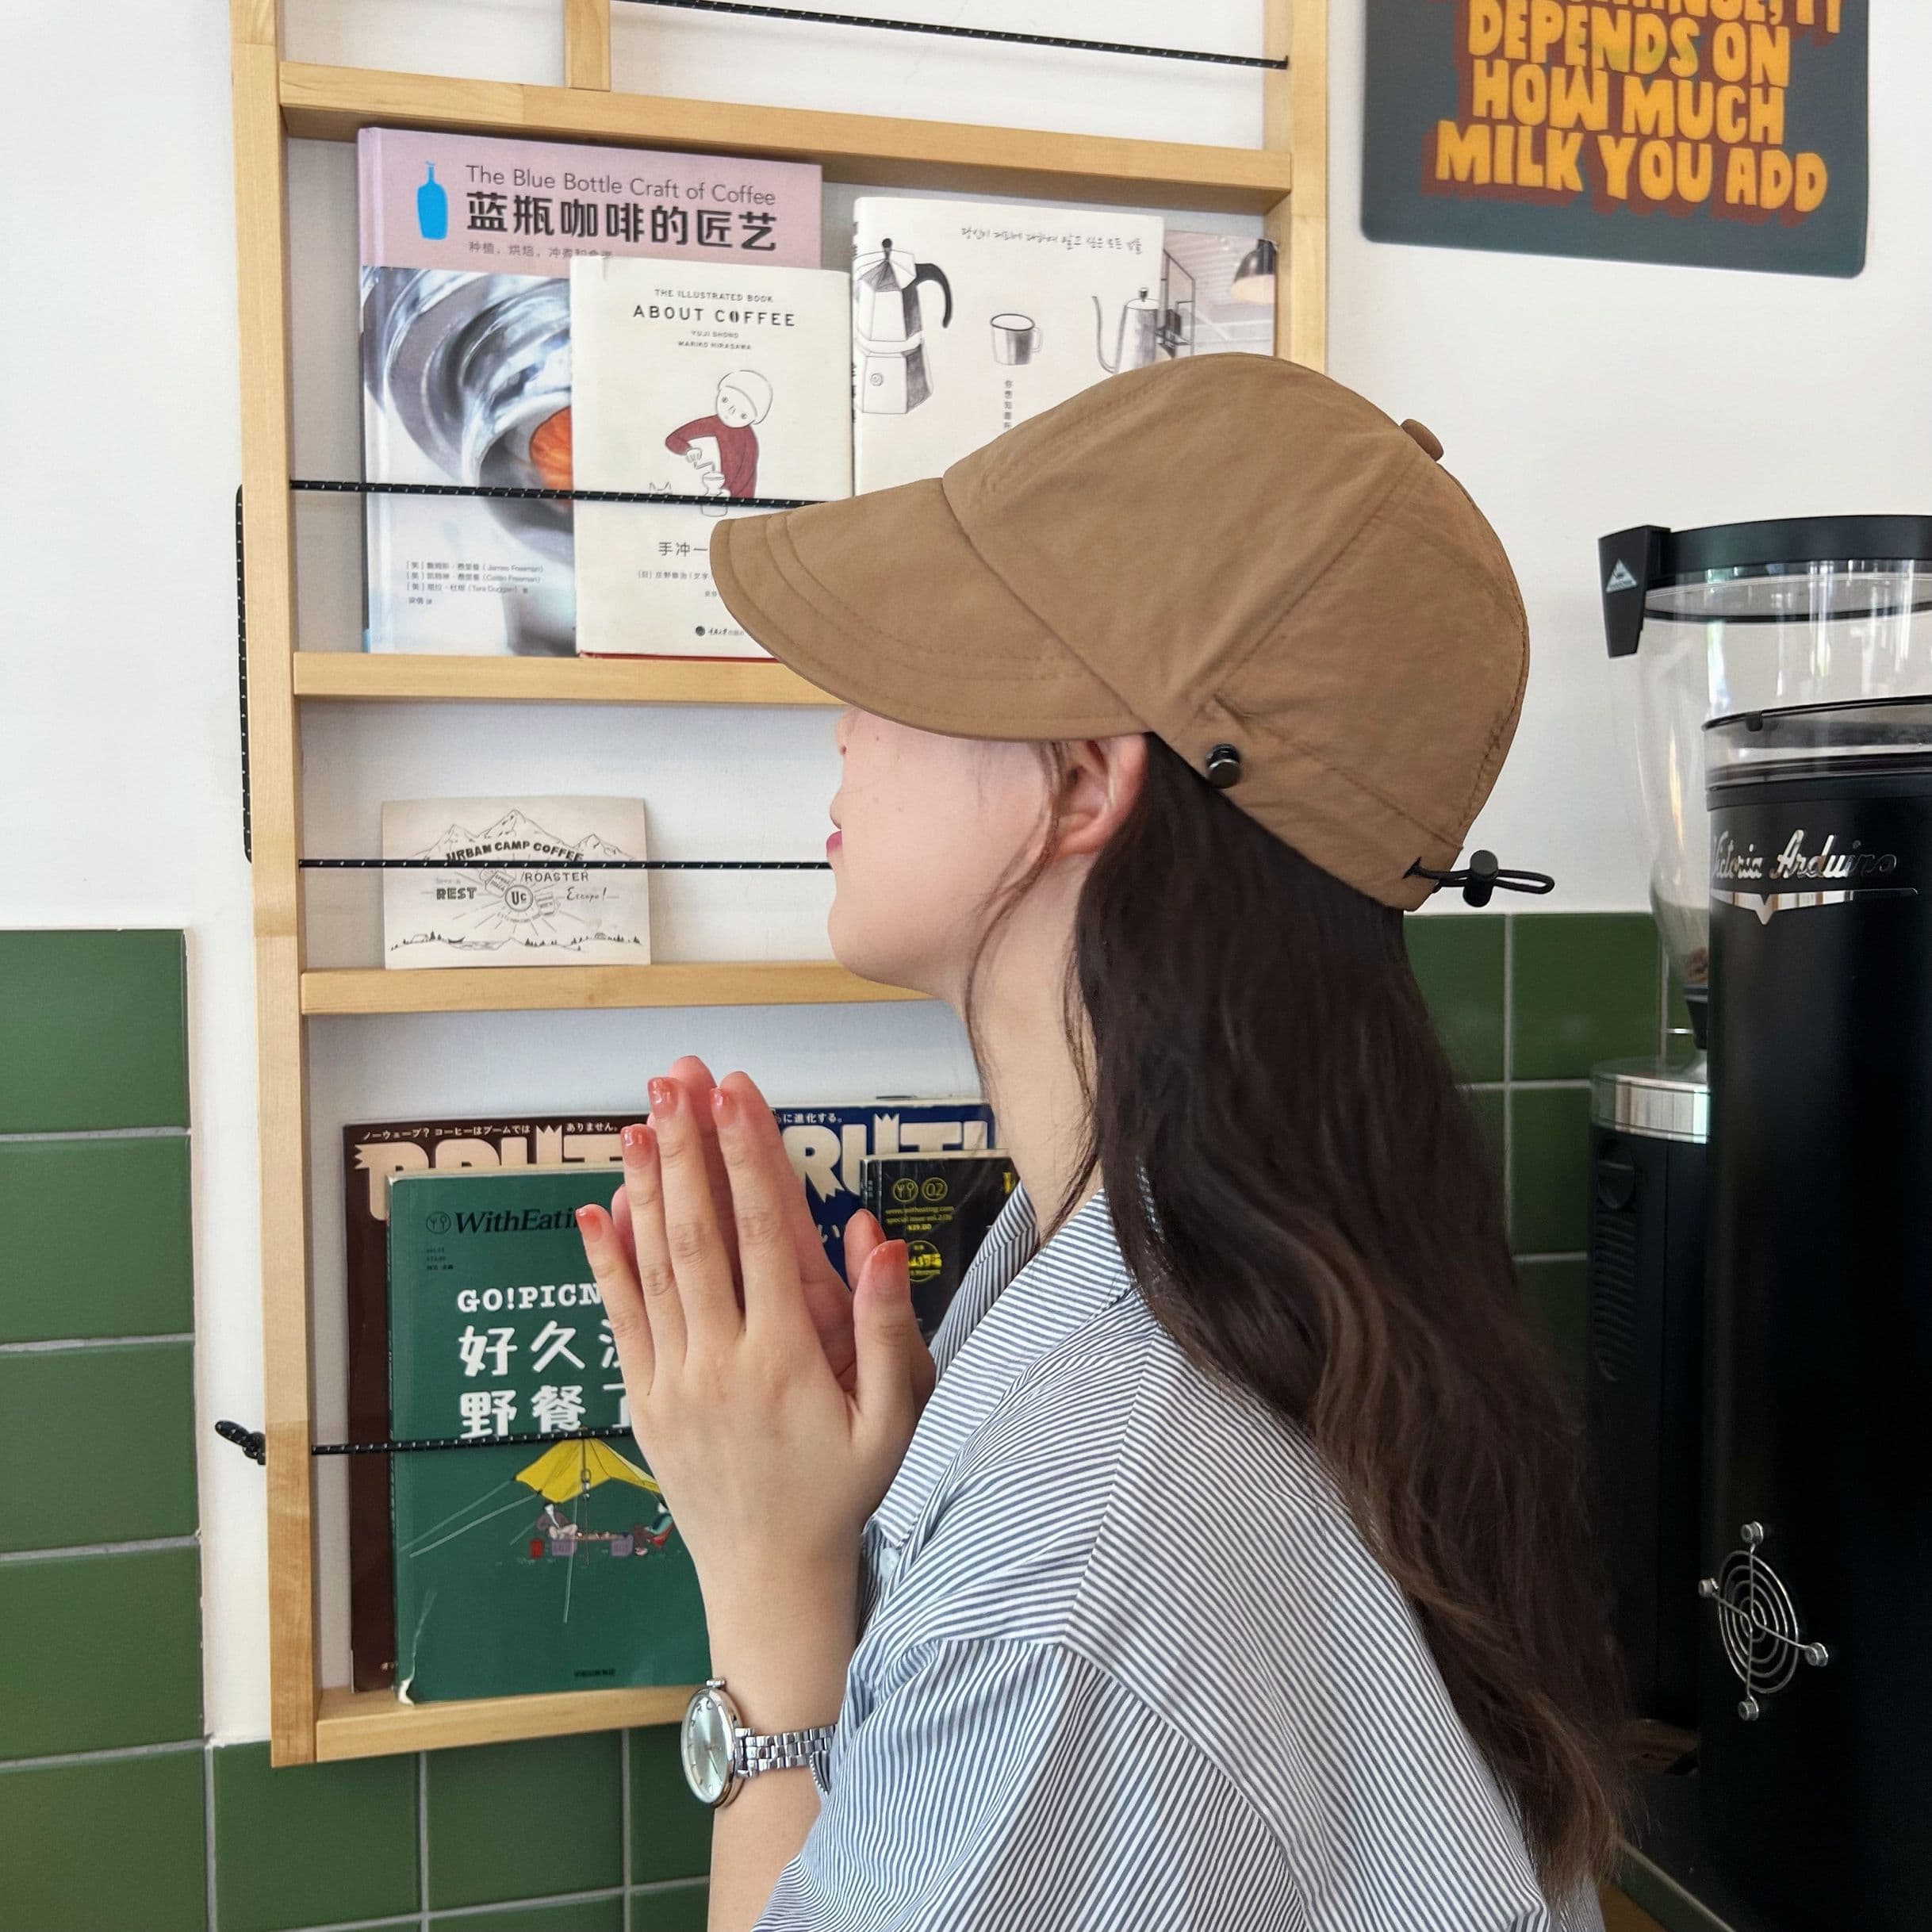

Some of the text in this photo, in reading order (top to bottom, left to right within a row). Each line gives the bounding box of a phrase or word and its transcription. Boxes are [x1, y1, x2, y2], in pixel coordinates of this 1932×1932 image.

[1468, 0, 1790, 87] DEPENDS ON
[1472, 59, 1785, 145] HOW MUCH
[1436, 121, 1828, 213] MILK YOU ADD
[466, 164, 776, 205] The Blue Bottle Craft of Coffee
[466, 191, 776, 251] 蓝瓶咖啡的匠艺
[654, 289, 673, 297] THE
[677, 290, 743, 301] ILLUSTRATED
[633, 305, 795, 327] ABOUT COFFEE
[446, 840, 585, 861] URBAN CAMP COFFEE
[525, 872, 589, 883] ROASTER
[436, 887, 477, 900] REST
